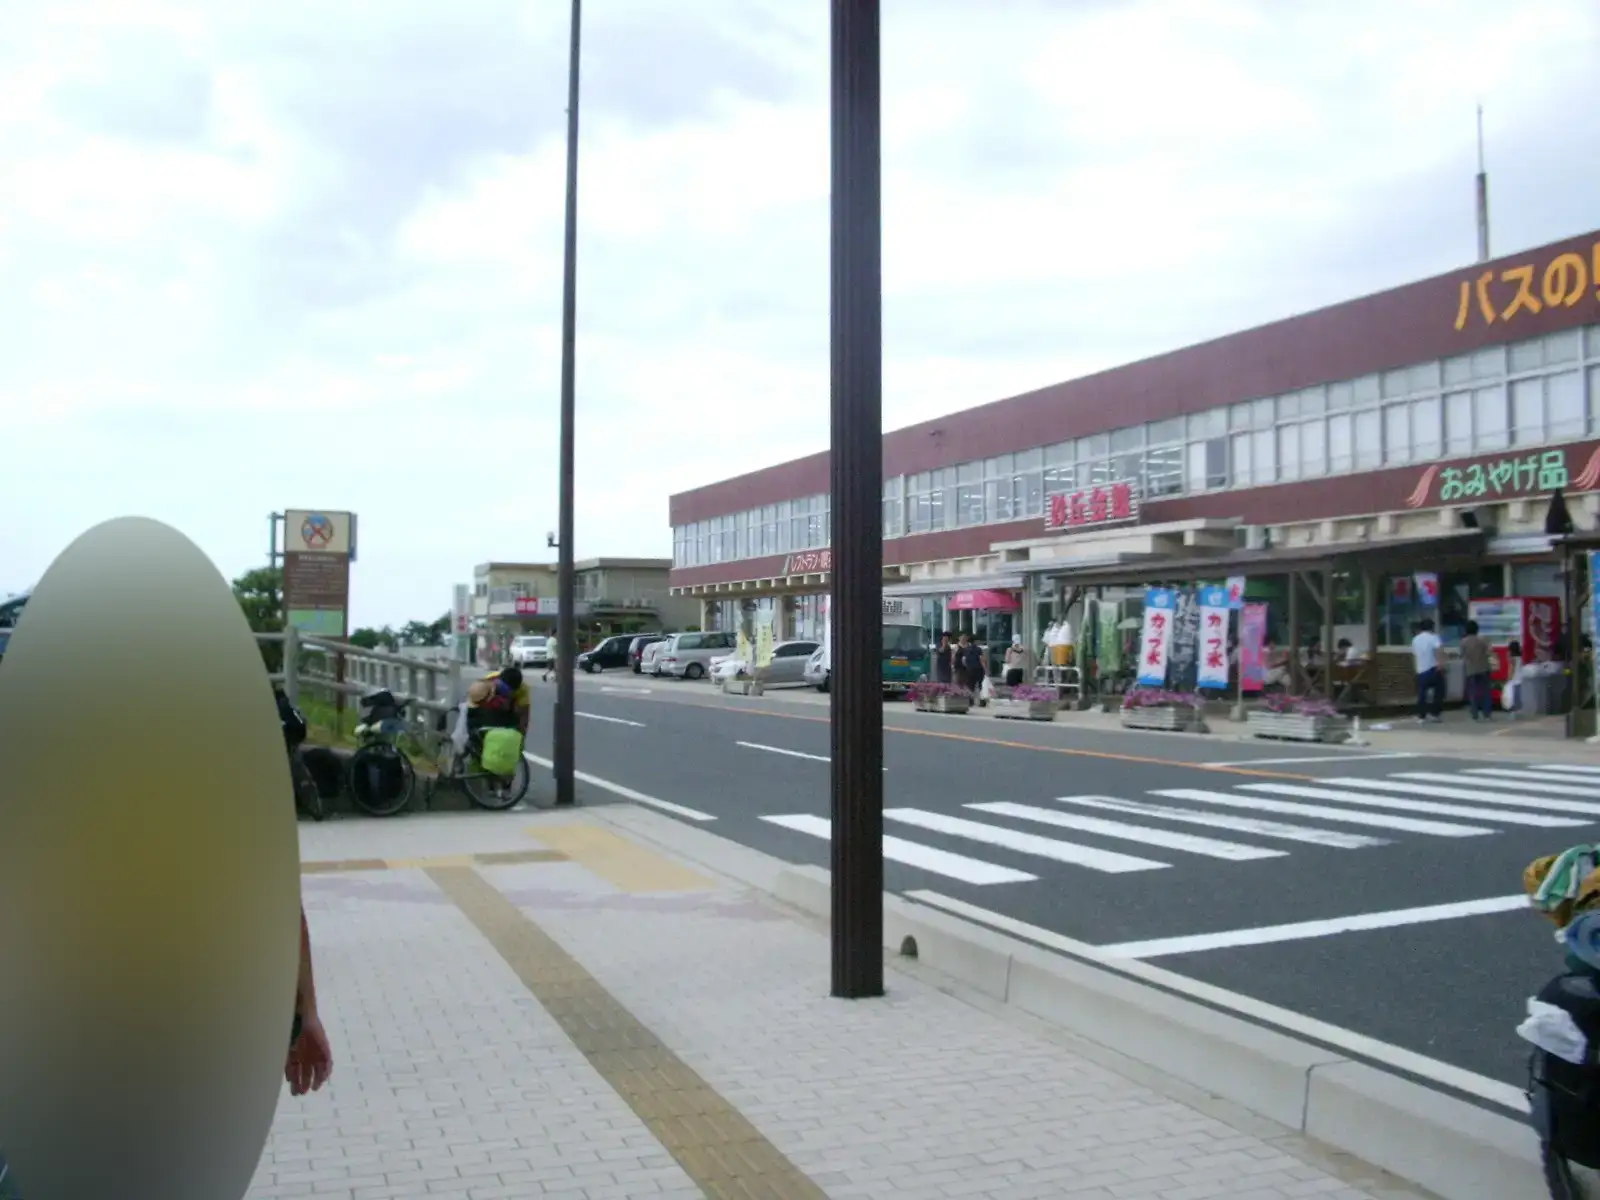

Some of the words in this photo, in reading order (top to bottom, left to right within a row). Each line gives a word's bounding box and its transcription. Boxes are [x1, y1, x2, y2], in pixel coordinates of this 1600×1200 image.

[1439, 450, 1568, 500] おみやげ品
